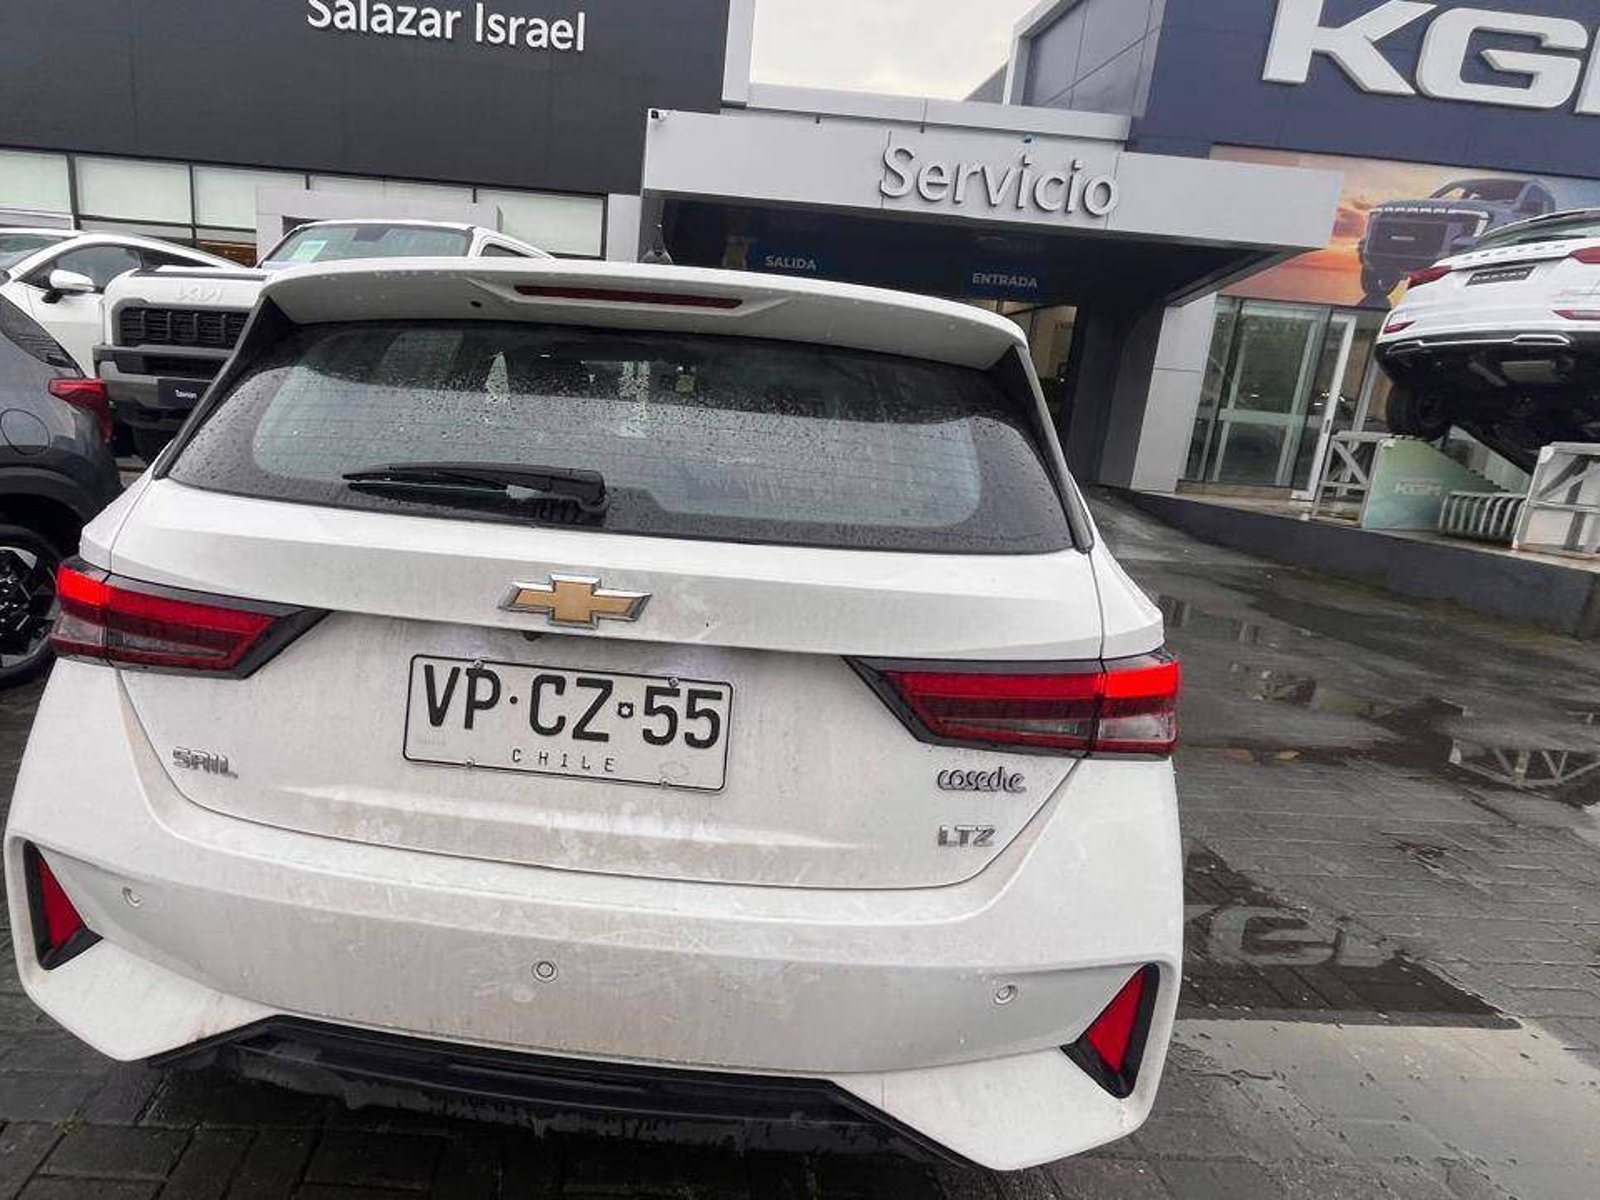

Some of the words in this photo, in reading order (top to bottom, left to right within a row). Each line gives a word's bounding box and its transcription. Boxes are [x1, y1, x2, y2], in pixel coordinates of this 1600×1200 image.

[306, 0, 462, 40] Salazar
[475, 3, 586, 51] Israel
[879, 147, 1119, 217] Servicio
[764, 254, 818, 271] SALIDA
[972, 271, 1038, 290] ENTRADA
[173, 746, 239, 780] SAIL
[511, 748, 616, 773] CHILE
[938, 824, 996, 848] LTZ
